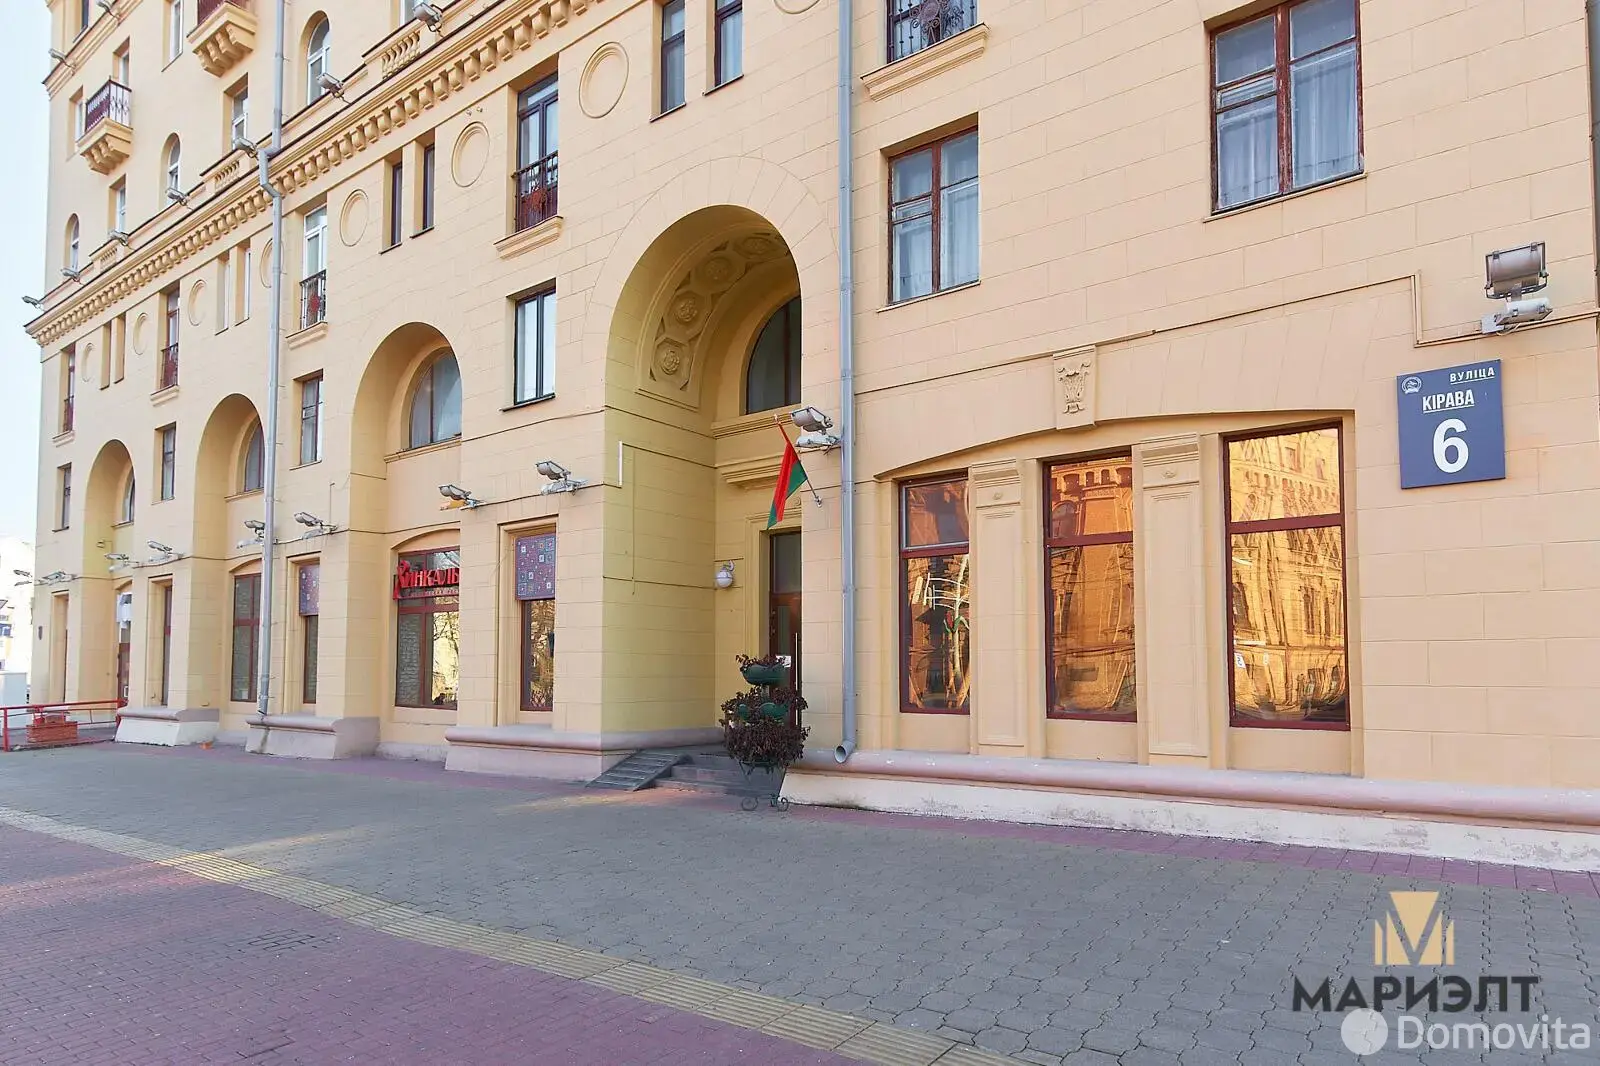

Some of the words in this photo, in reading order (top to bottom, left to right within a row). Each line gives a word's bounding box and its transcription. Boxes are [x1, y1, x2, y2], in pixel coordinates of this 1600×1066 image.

[1449, 367, 1495, 383] ВУЛІЦА
[1422, 389, 1475, 412] КІРАВА
[1433, 418, 1469, 473] 6
